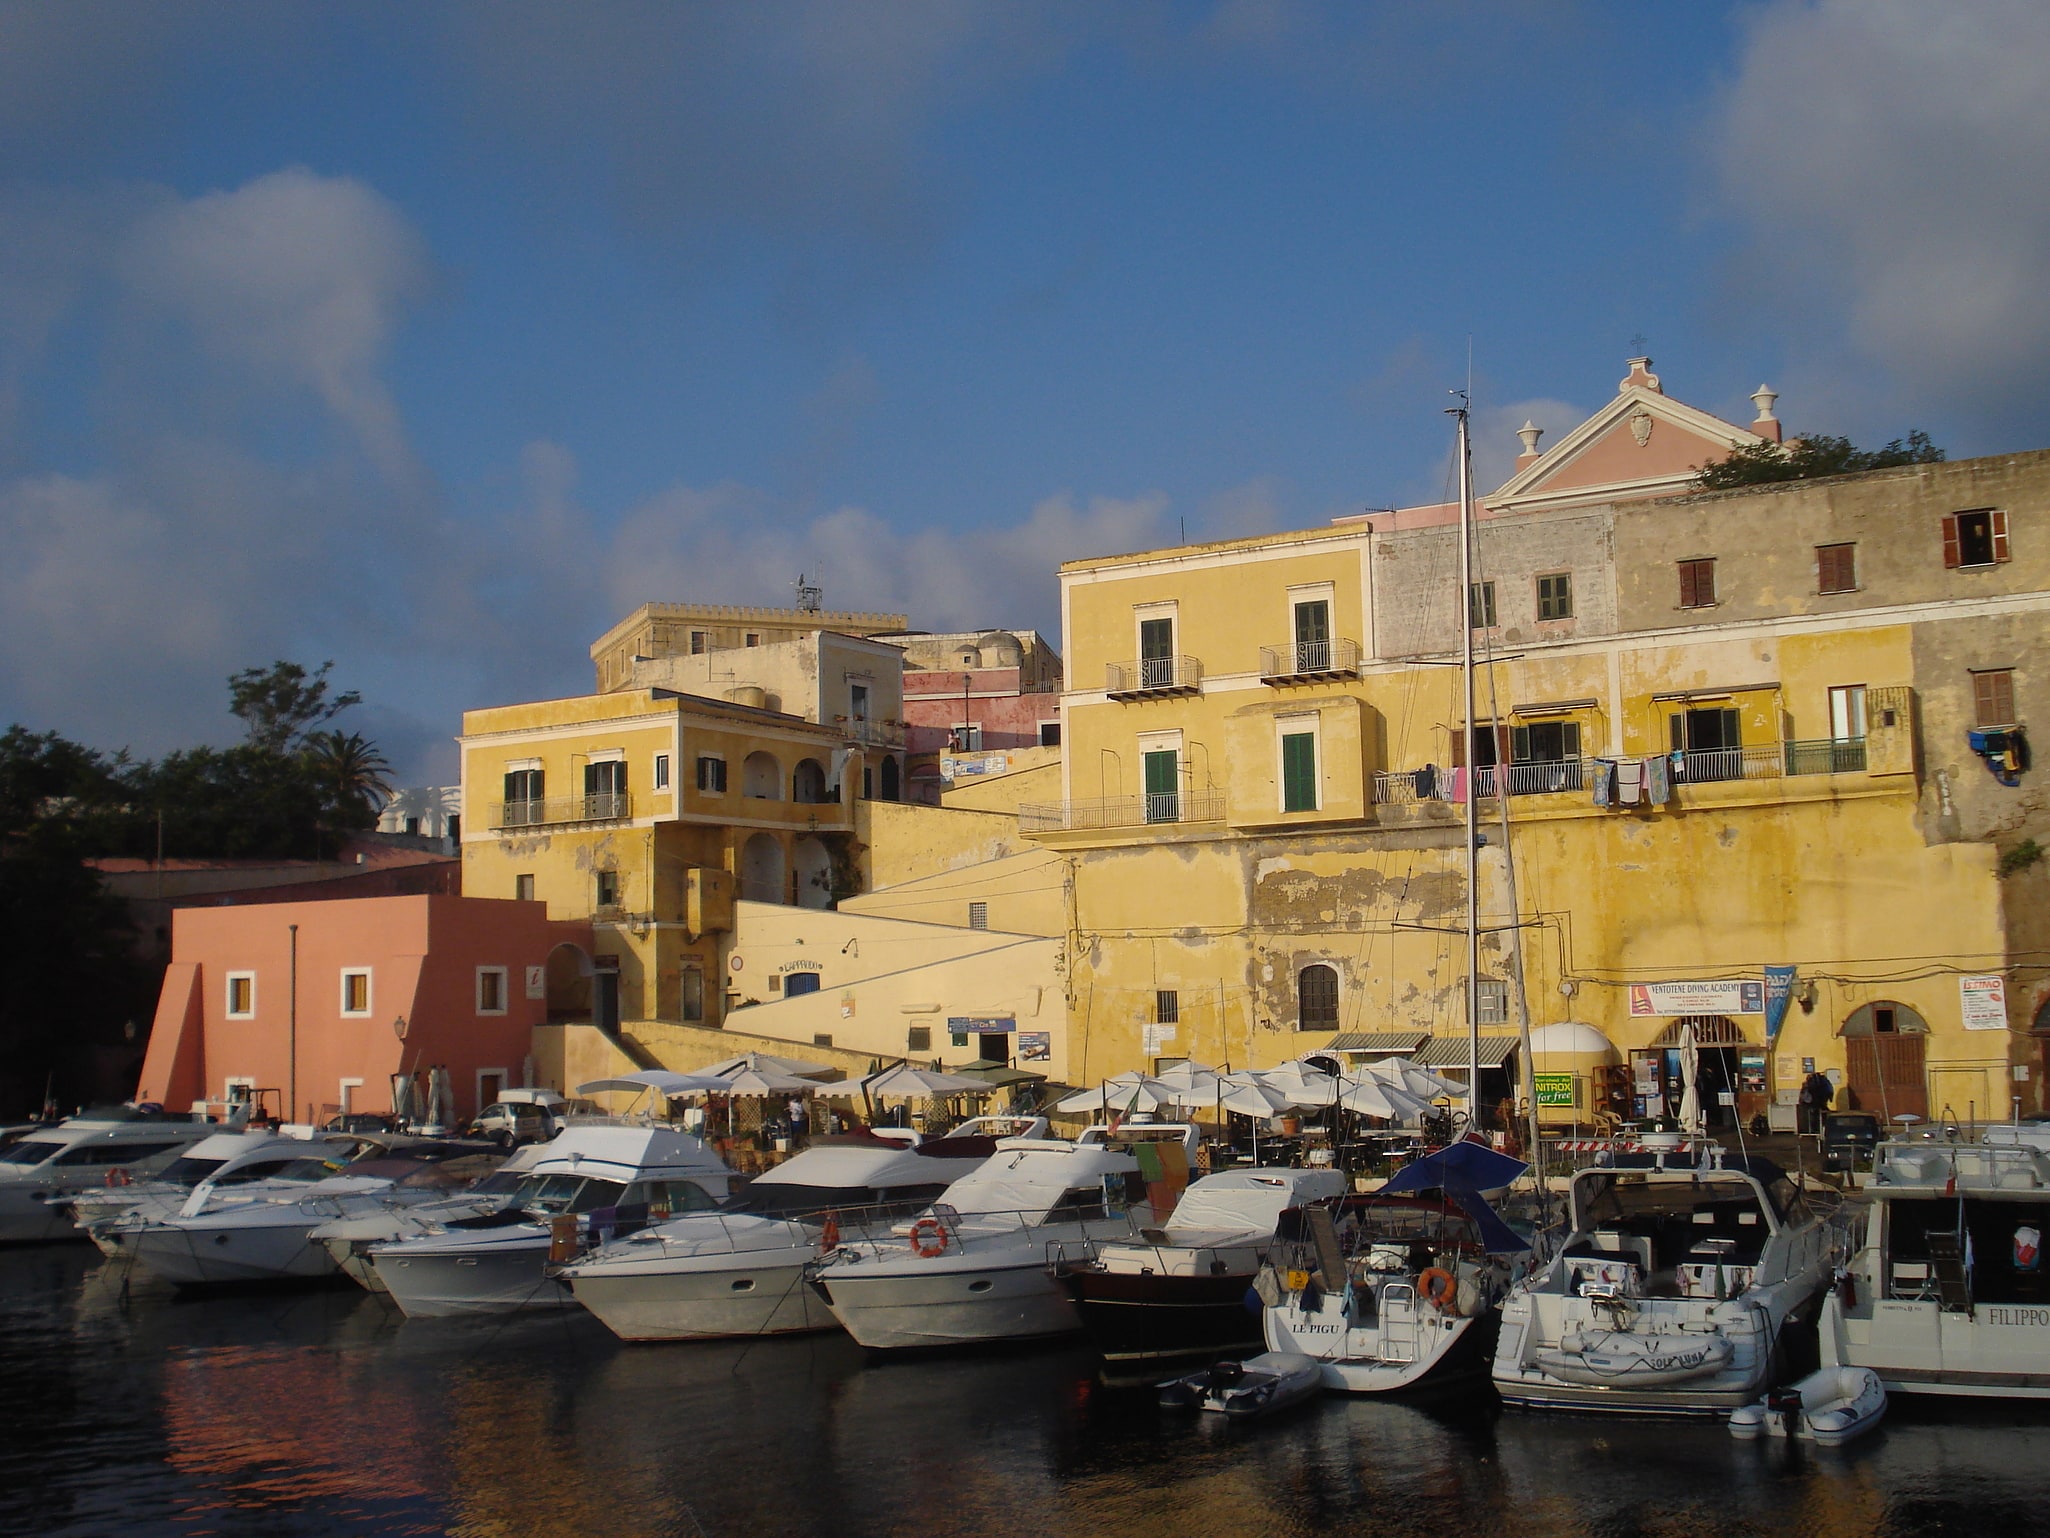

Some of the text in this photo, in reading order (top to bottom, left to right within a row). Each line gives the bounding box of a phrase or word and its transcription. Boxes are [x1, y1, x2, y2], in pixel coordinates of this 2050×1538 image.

[1651, 983, 1740, 994] VENTOTENE DIVING ACADEMY
[1535, 1082, 1571, 1092] NITROX
[1537, 1091, 1571, 1104] for free
[1990, 1308, 2050, 1326] FILIPPO
[1293, 1324, 1340, 1334] LE PIGU
